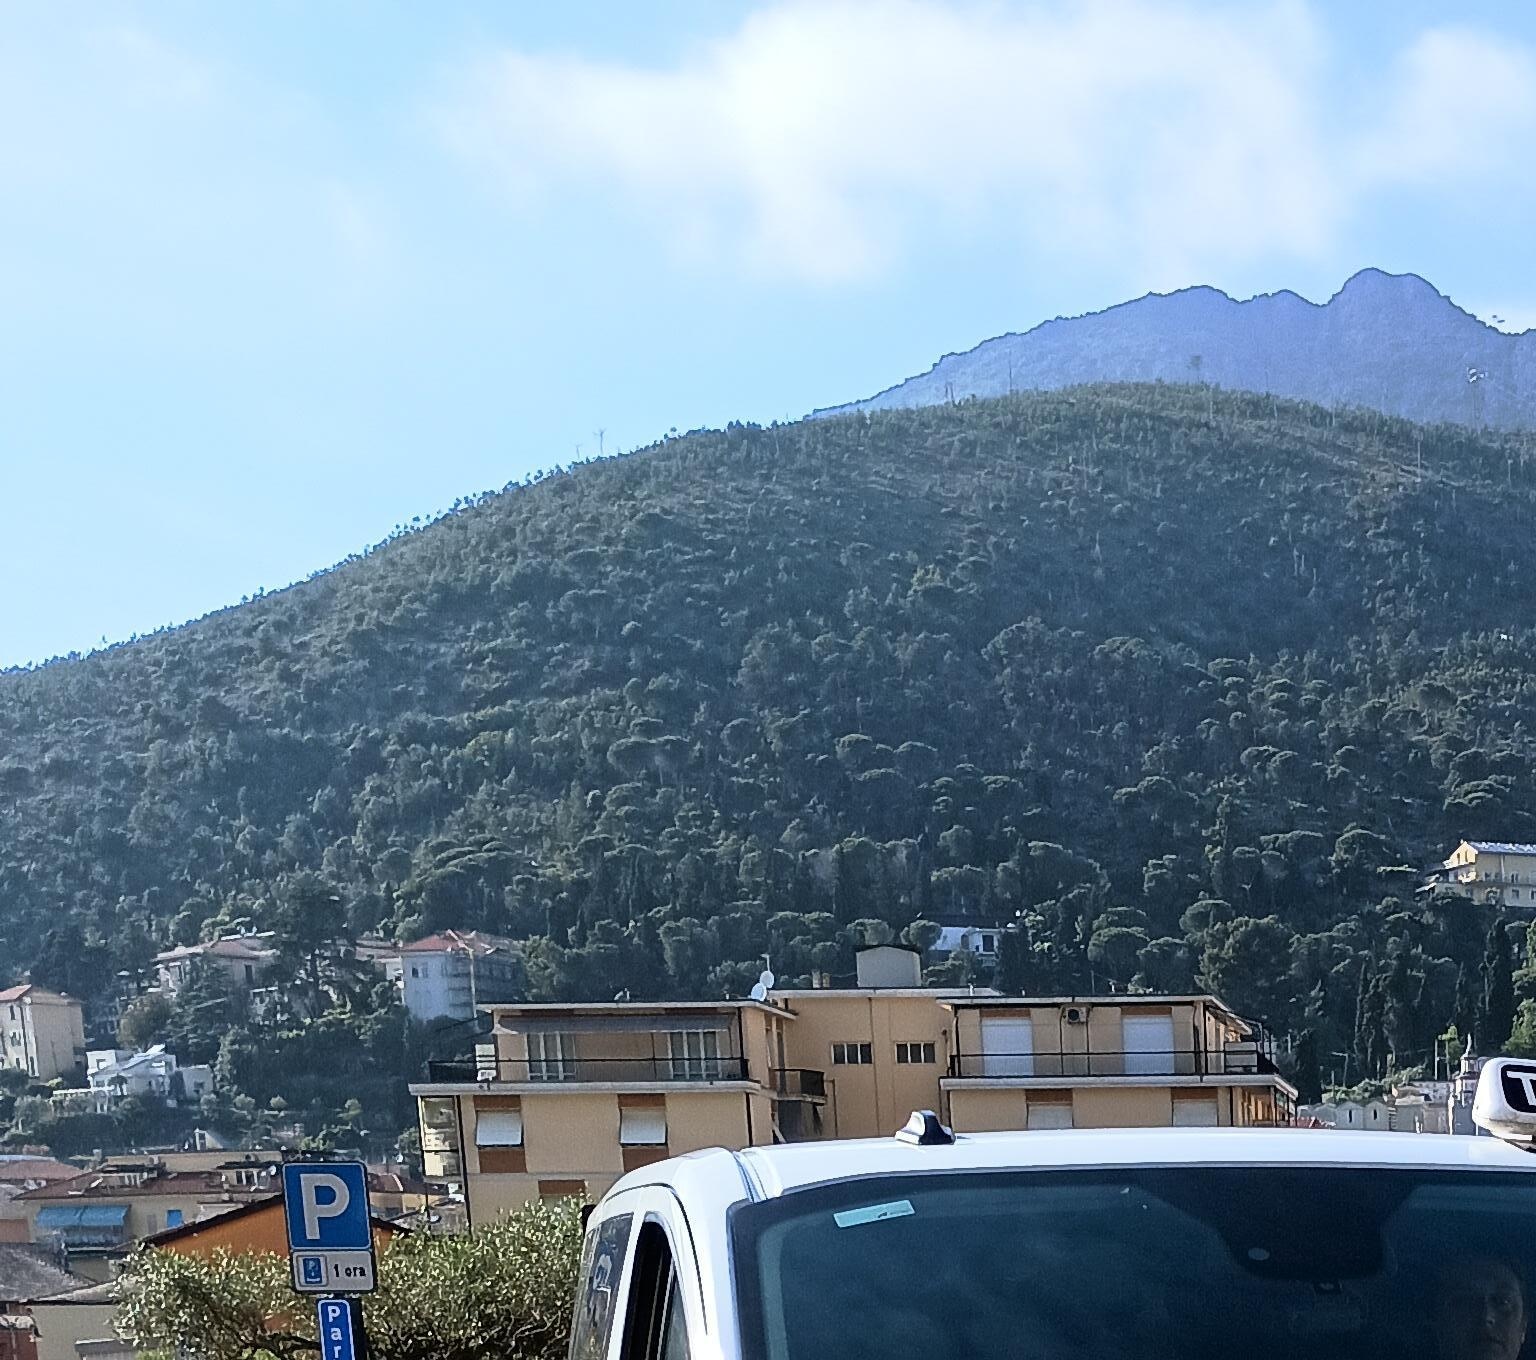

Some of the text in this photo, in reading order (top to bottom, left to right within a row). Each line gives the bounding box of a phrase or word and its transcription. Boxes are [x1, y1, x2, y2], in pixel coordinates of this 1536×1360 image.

[300, 1174, 350, 1240] P
[334, 1264, 366, 1278] 1 ora
